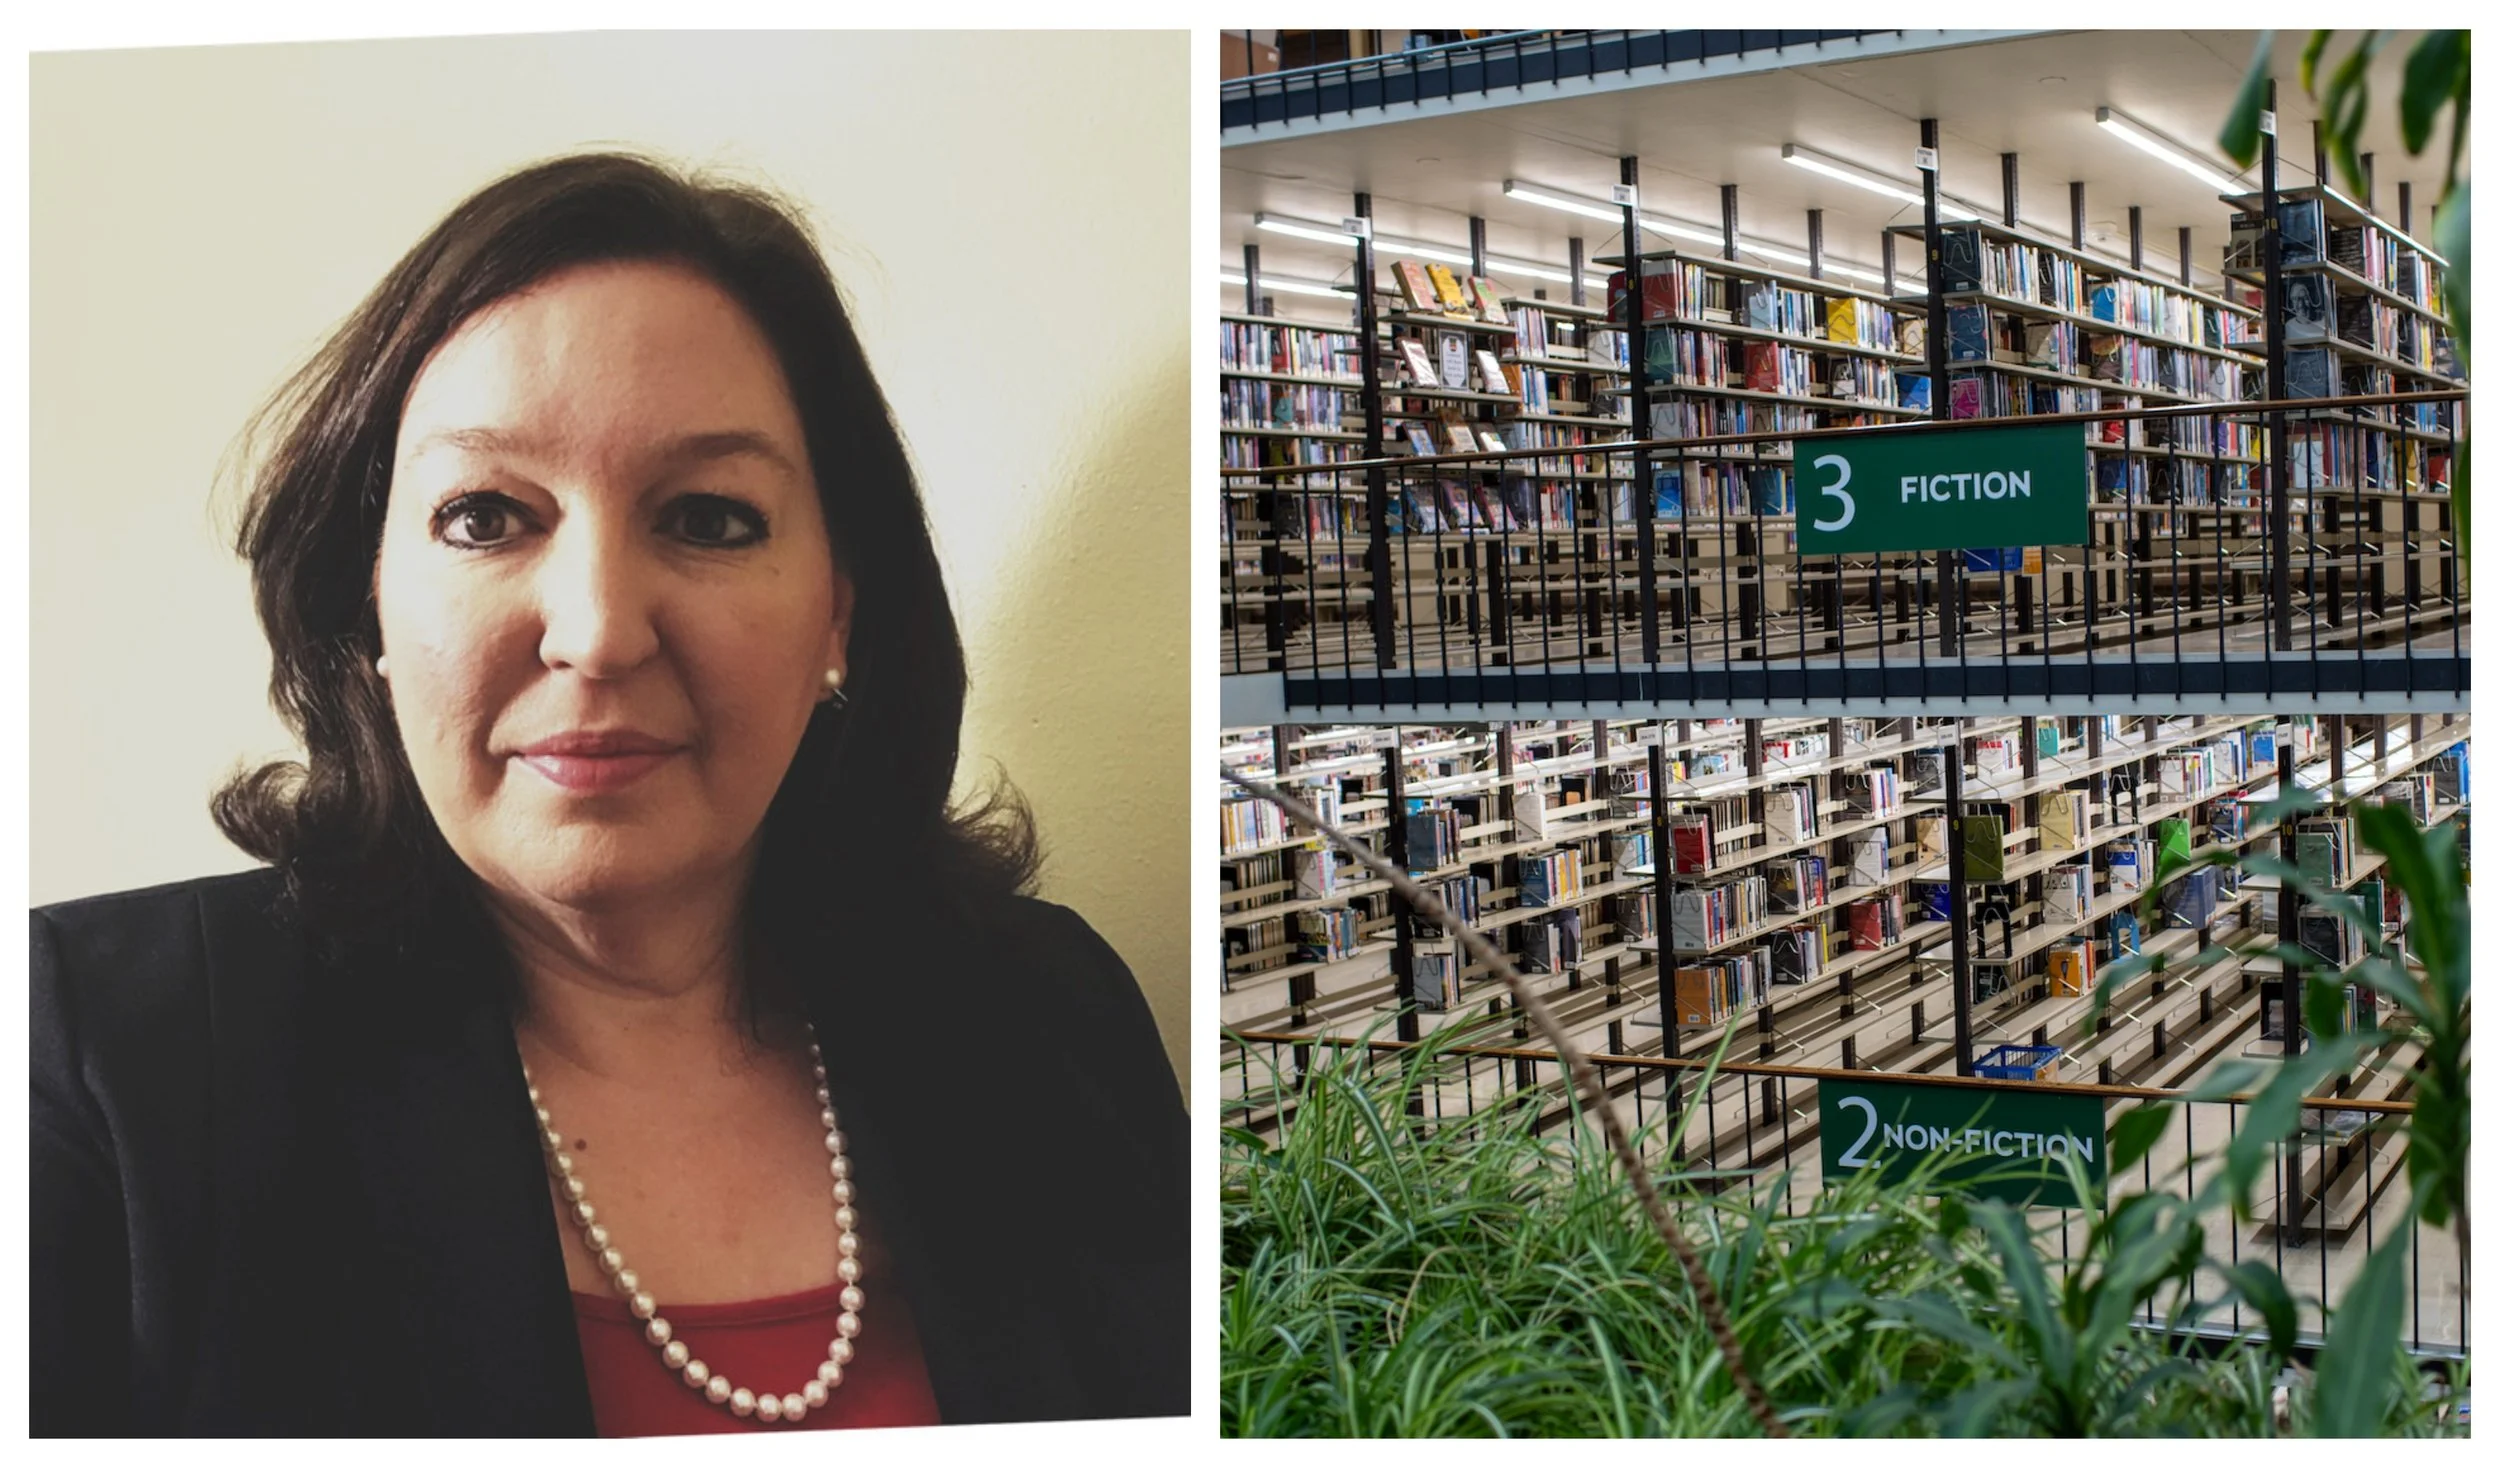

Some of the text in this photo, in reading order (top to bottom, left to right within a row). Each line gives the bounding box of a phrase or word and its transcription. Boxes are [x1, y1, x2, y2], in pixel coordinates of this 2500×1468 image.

[1813, 454, 2031, 532] 3 FICTION
[2282, 823, 2293, 836] 10
[1838, 1095, 2094, 1169] 2 NON-FICTION
